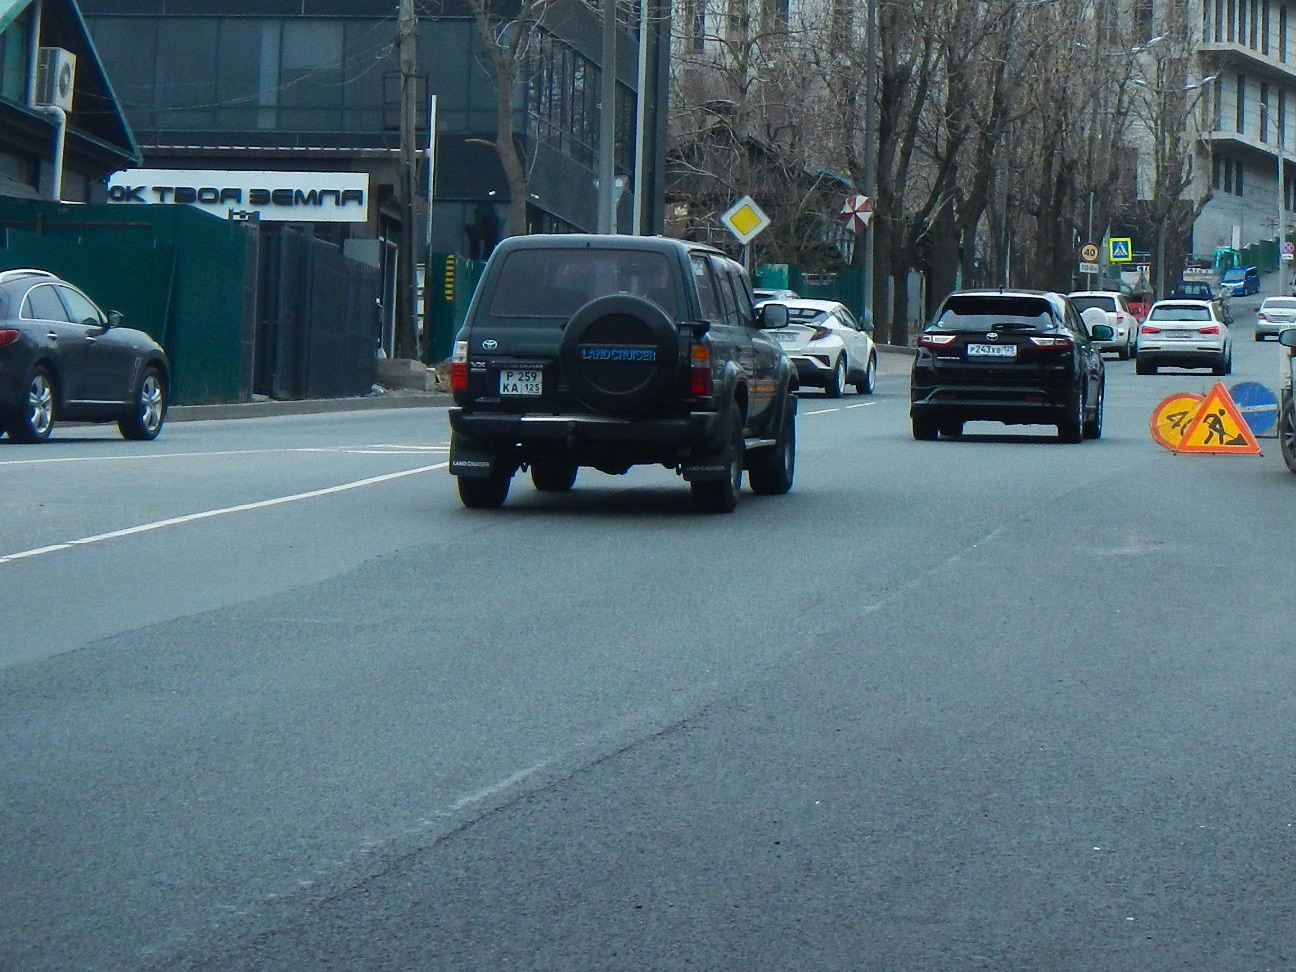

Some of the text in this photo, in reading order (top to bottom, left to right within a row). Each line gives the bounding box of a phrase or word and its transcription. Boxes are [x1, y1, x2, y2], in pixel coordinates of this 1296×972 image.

[1084, 248, 1095, 257] 40
[518, 371, 537, 381] 259
[524, 383, 540, 391] 125
